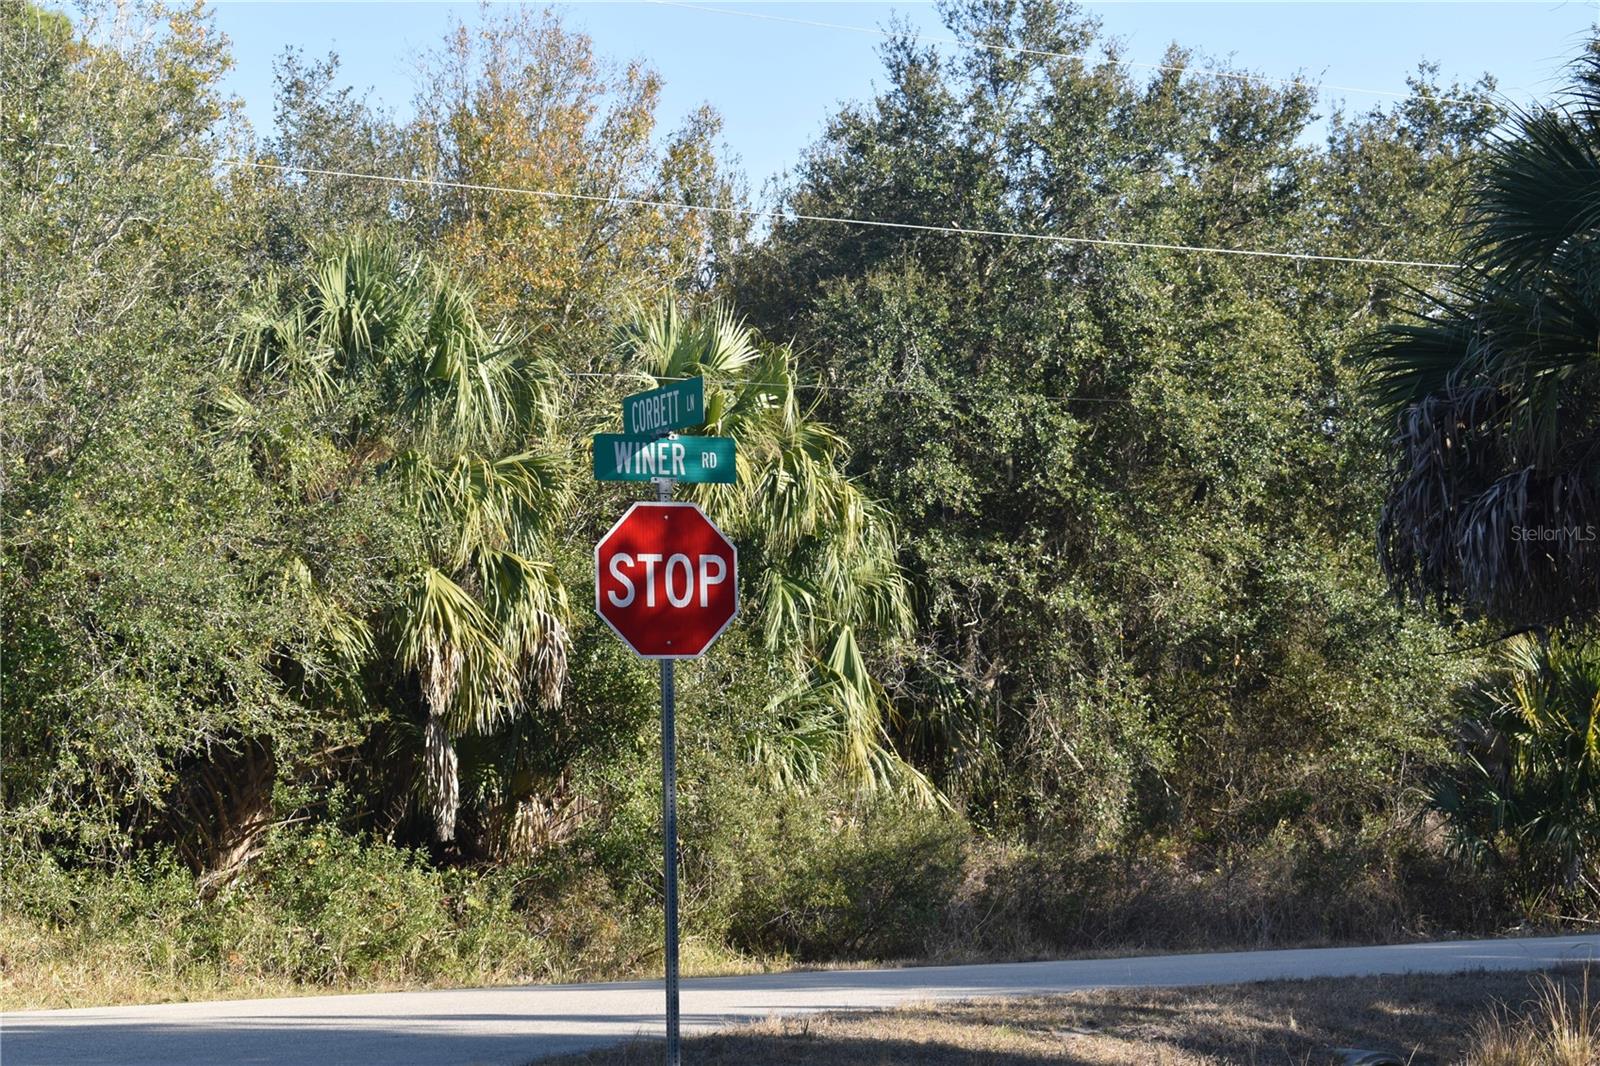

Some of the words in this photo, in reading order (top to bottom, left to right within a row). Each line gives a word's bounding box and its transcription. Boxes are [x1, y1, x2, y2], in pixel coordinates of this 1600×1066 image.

[632, 390, 679, 434] CORBETT
[686, 393, 695, 412] LN
[614, 441, 686, 475] WINER
[701, 451, 717, 469] RD
[607, 552, 727, 609] STOP
